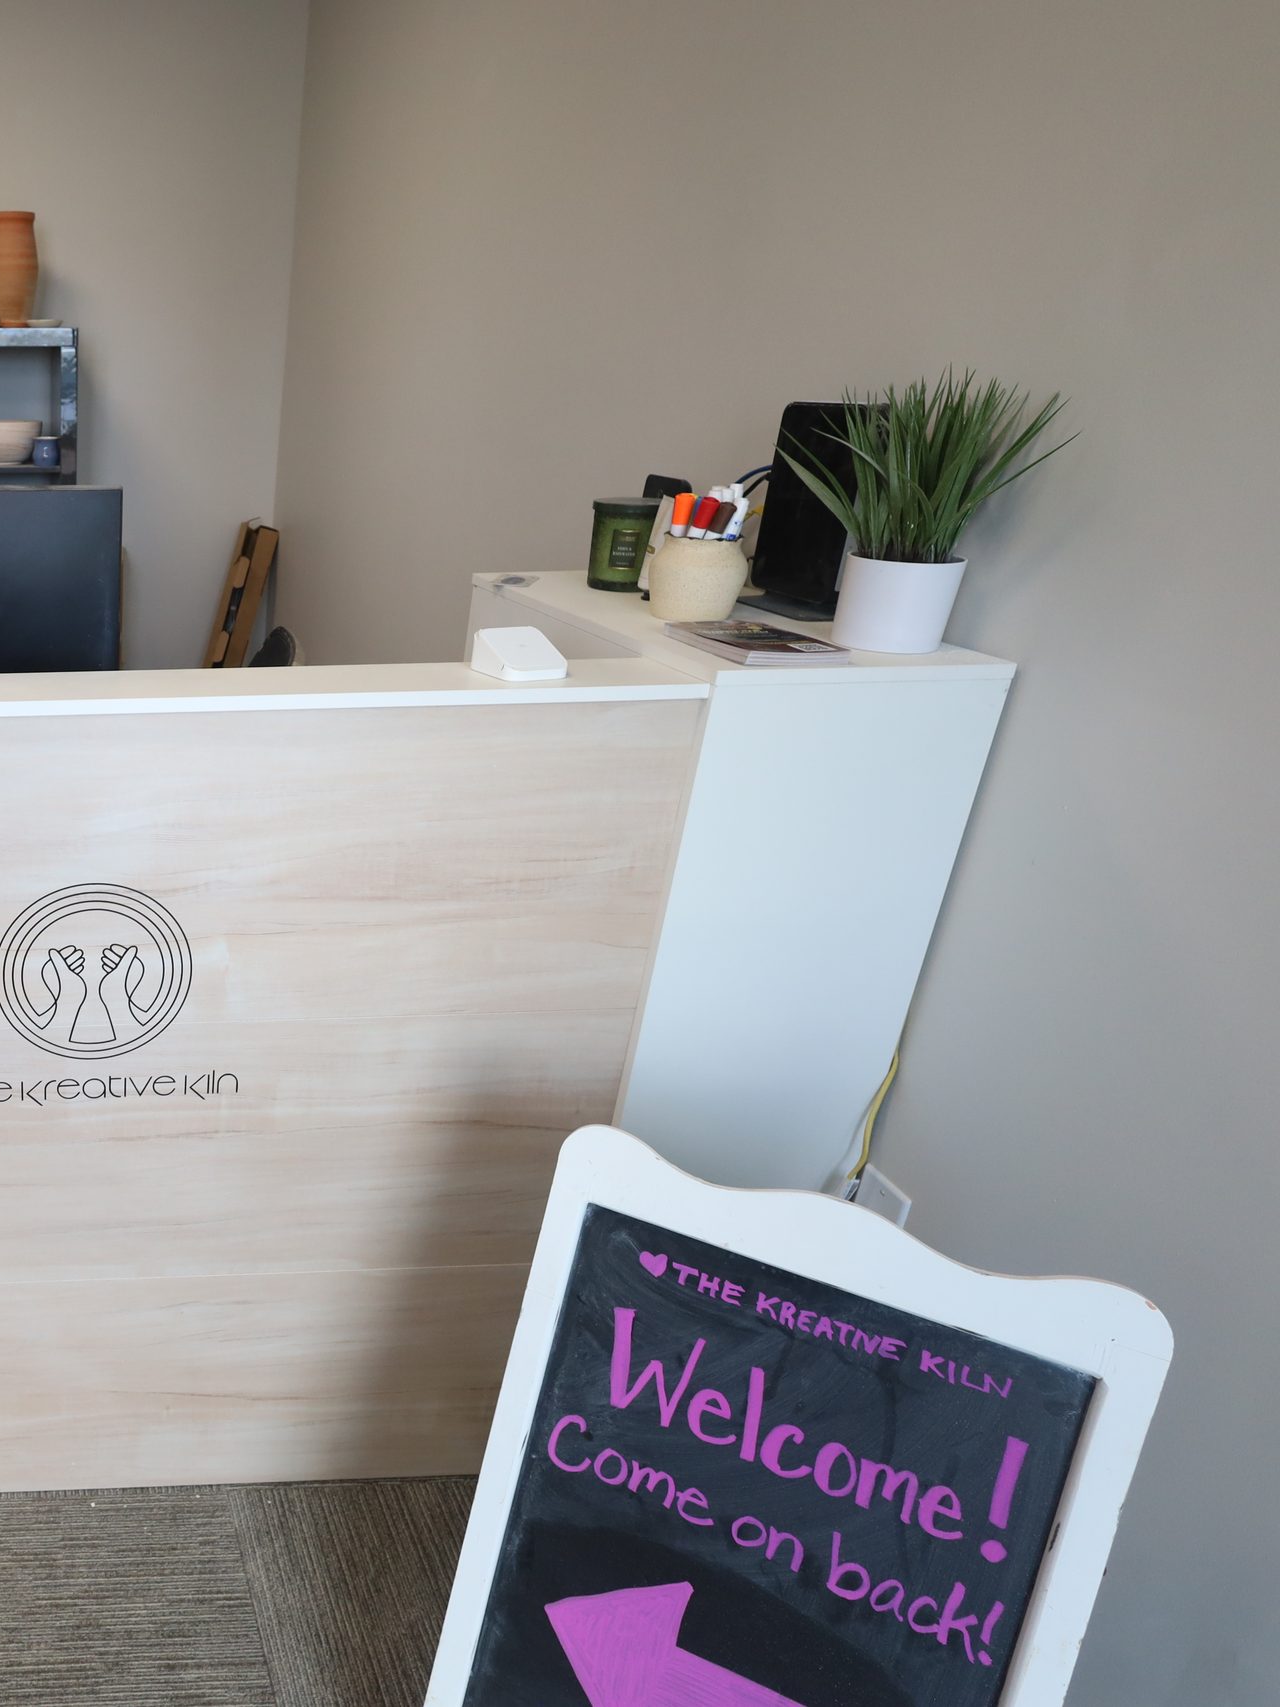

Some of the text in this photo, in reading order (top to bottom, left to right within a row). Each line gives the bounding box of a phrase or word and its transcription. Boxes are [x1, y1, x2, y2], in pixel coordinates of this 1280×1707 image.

[21, 1075, 176, 1106] Kreative
[184, 1069, 239, 1100] Kiln
[672, 1260, 1013, 1398] THE KREATIVE KILN
[610, 1307, 1029, 1563] Welcome!
[547, 1415, 1005, 1666] Come on back!
